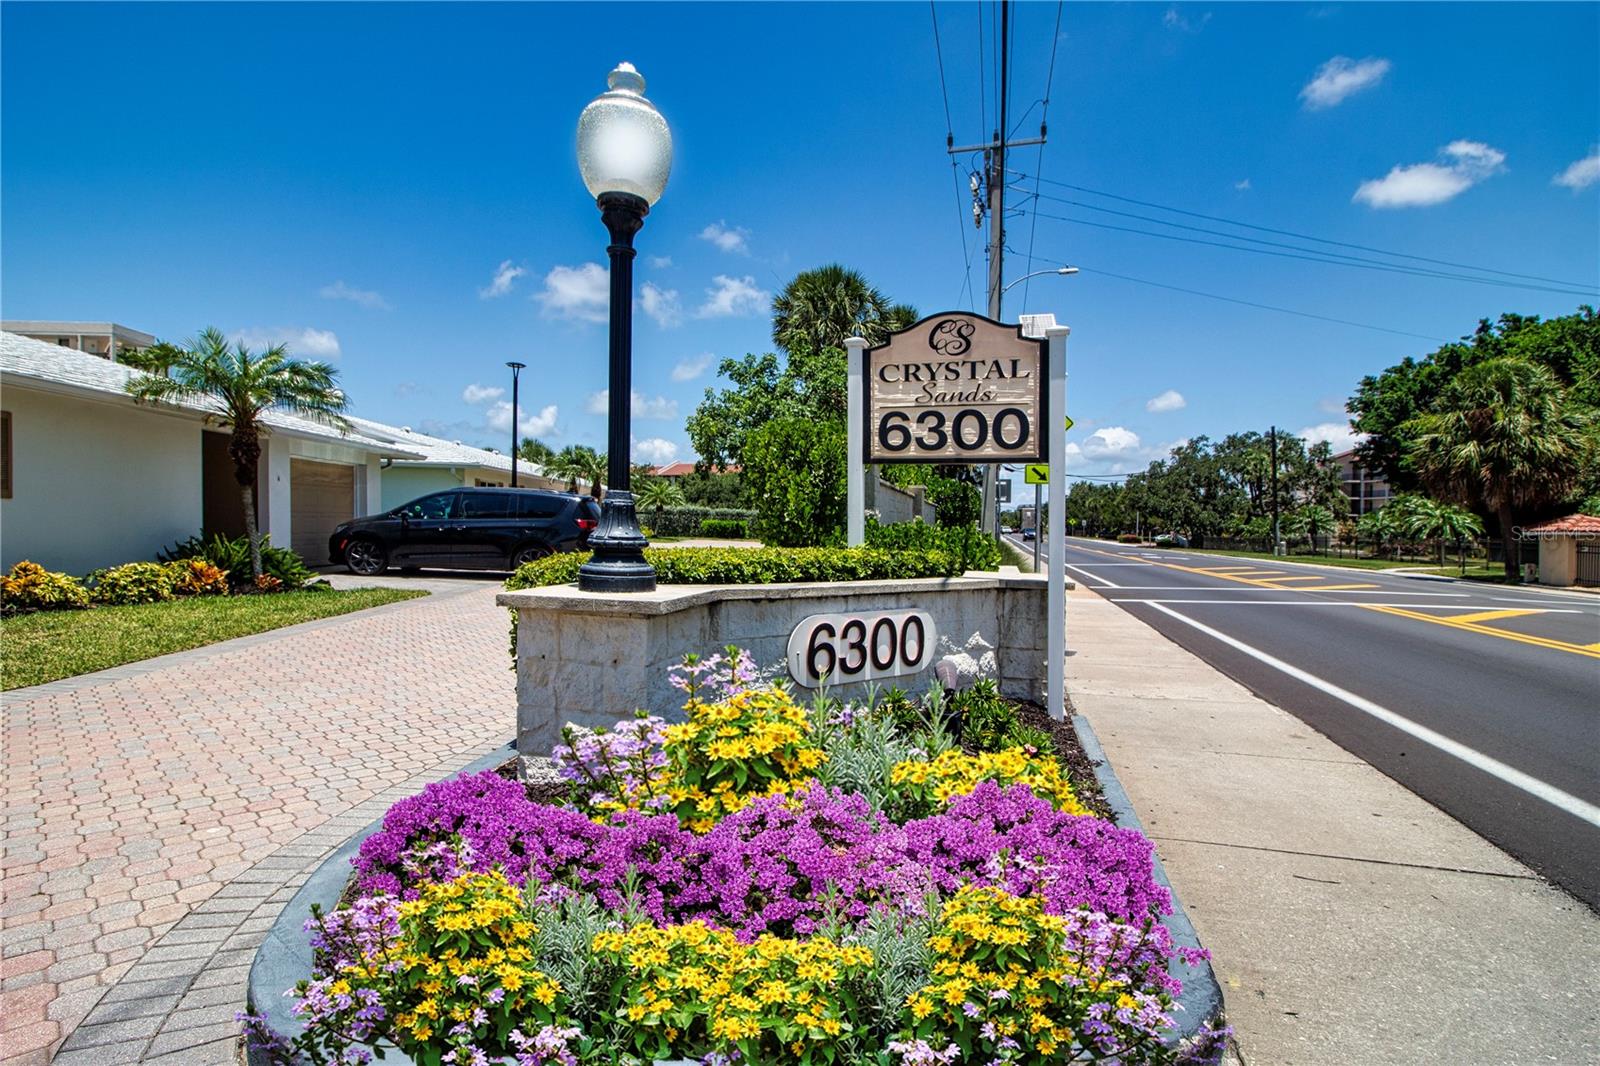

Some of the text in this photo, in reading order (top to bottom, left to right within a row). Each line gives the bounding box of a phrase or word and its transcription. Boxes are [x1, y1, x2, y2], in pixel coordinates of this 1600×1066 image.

[879, 359, 1030, 382] CRYSTAL
[915, 382, 998, 403] Sands
[878, 408, 1030, 451] 6300
[807, 615, 925, 680] 6300
